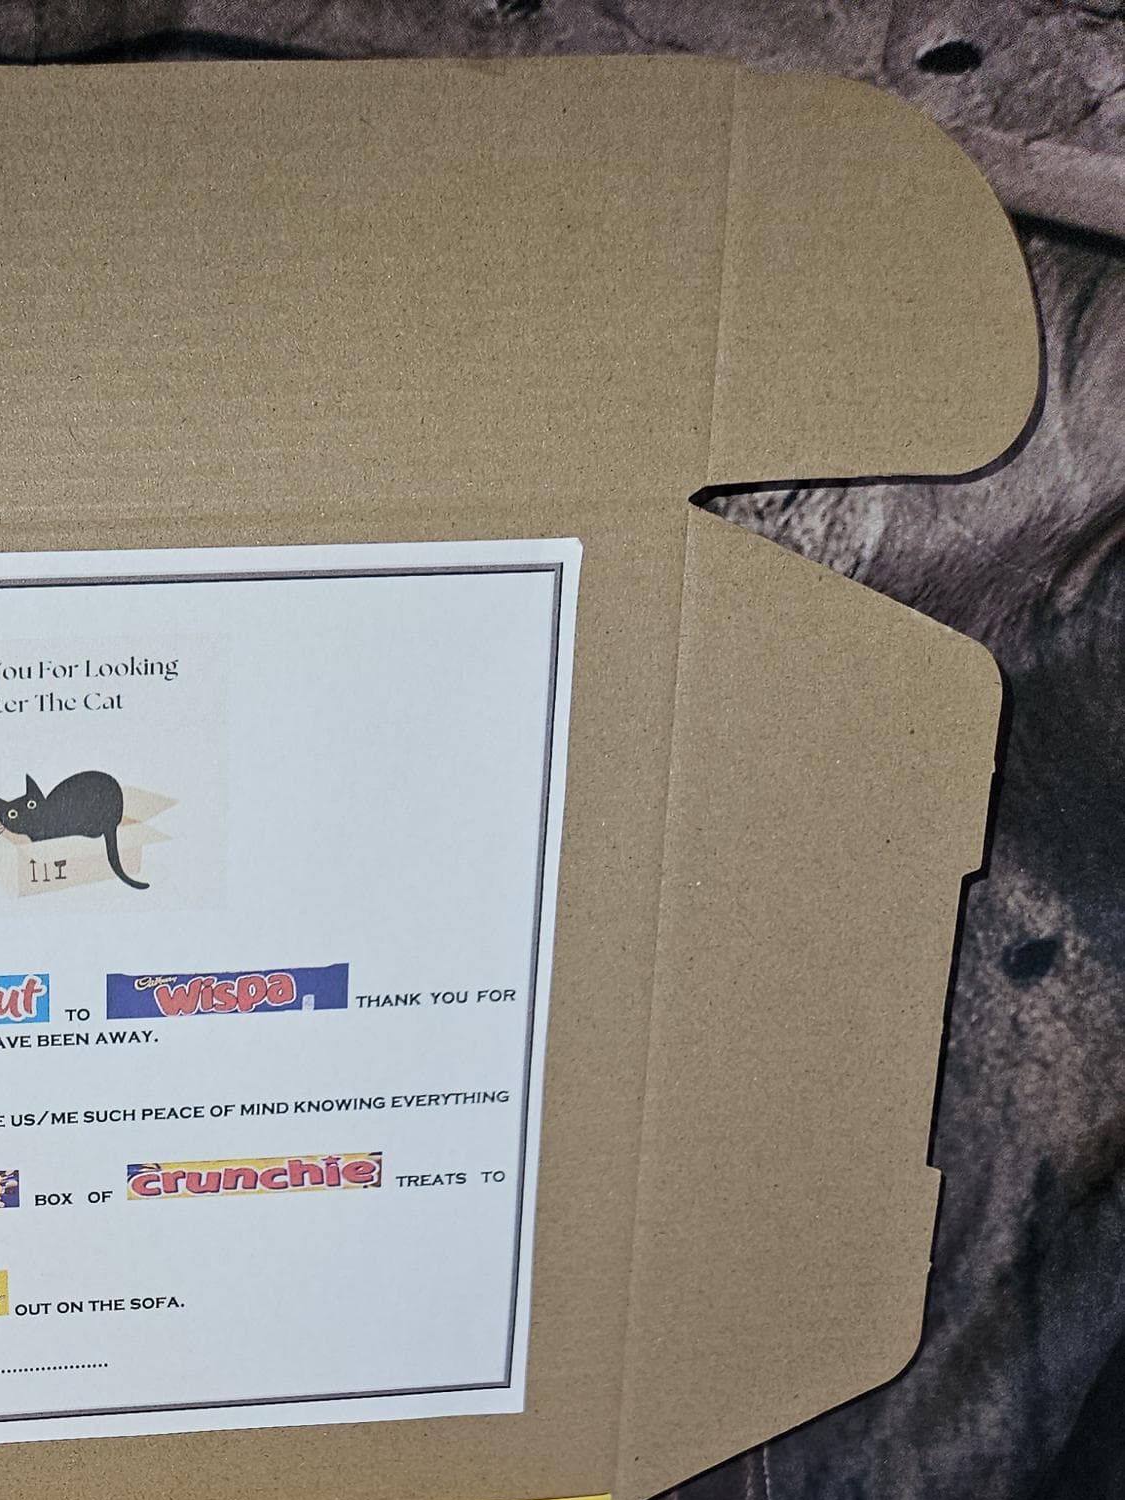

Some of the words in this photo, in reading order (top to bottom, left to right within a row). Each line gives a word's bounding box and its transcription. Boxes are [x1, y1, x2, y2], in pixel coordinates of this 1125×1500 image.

[39, 661, 79, 678] For
[86, 656, 178, 681] Looking
[35, 692, 76, 711] The
[84, 693, 122, 710] Cat
[65, 1009, 90, 1021] TO
[156, 974, 297, 1016] Wispa
[356, 994, 421, 1008] THANK
[431, 992, 467, 1004] YOU
[477, 990, 515, 1002] FOR
[38, 1033, 89, 1047] BEEN
[96, 1031, 158, 1044] AWAY.
[11, 1111, 78, 1126] US/ME
[84, 1110, 135, 1123] SUCH
[142, 1106, 204, 1120] PEACE
[210, 1105, 235, 1117] OF
[241, 1103, 288, 1116] MIND
[294, 1097, 385, 1113] KNOWING
[391, 1091, 509, 1108] EVERYTHING
[35, 1193, 72, 1206] BOX
[88, 1191, 113, 1203] OF
[129, 1156, 379, 1198] crunchie
[396, 1173, 466, 1187] TREATS
[481, 1171, 505, 1182] TO
[15, 1303, 51, 1316] OUT
[57, 1302, 83, 1313] ON
[88, 1299, 125, 1311] THE
[131, 1297, 184, 1310] SOFA.
